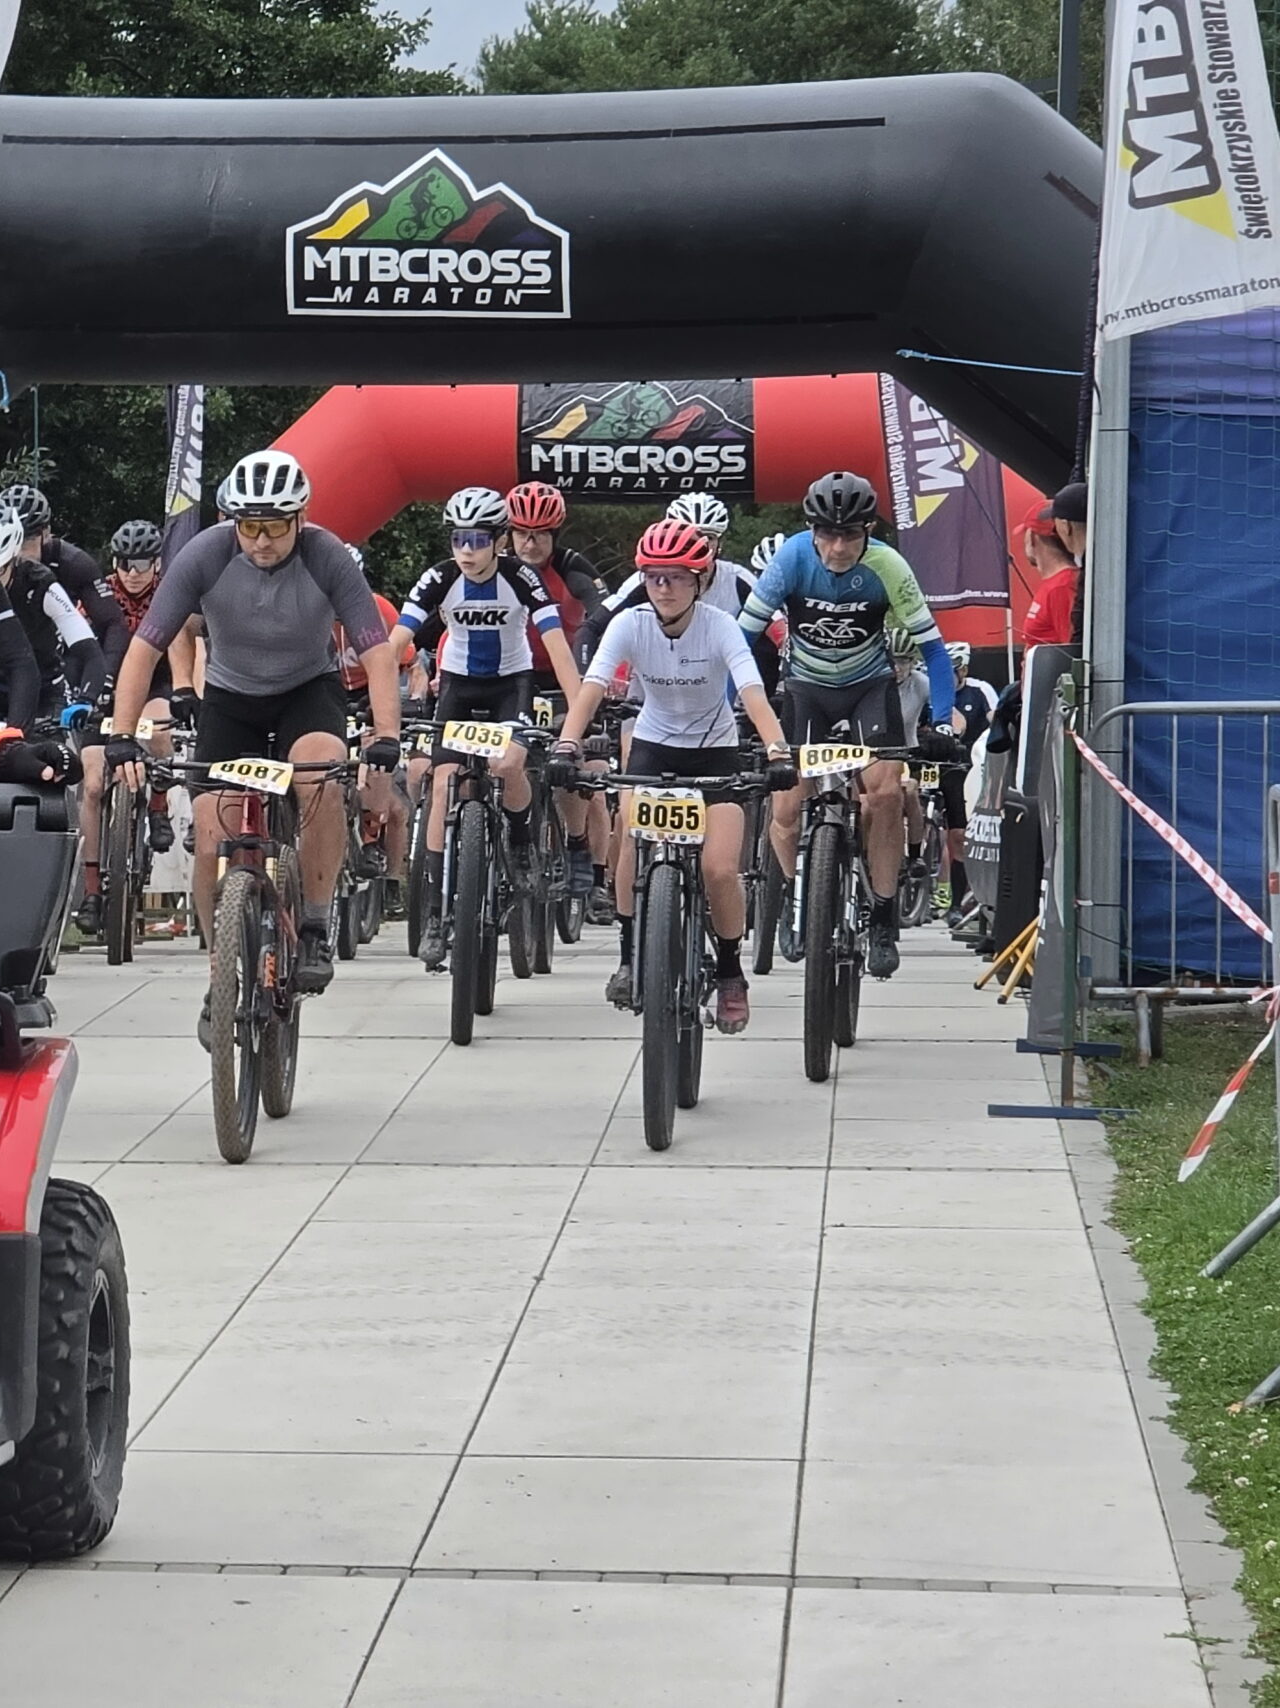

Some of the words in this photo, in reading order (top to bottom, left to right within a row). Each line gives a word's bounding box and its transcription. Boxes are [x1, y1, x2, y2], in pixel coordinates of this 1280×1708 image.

[1215, 88, 1272, 240] Świętokrzyskie
[303, 246, 552, 285] MTBCROSS
[332, 286, 523, 306] MARATON
[530, 443, 747, 473] MTBCROSS
[555, 475, 721, 489] MARATON
[804, 597, 870, 613] TREK
[451, 722, 505, 747] 7035
[806, 747, 864, 766] 8040
[220, 763, 287, 783] 8087
[637, 802, 700, 831] 8055
